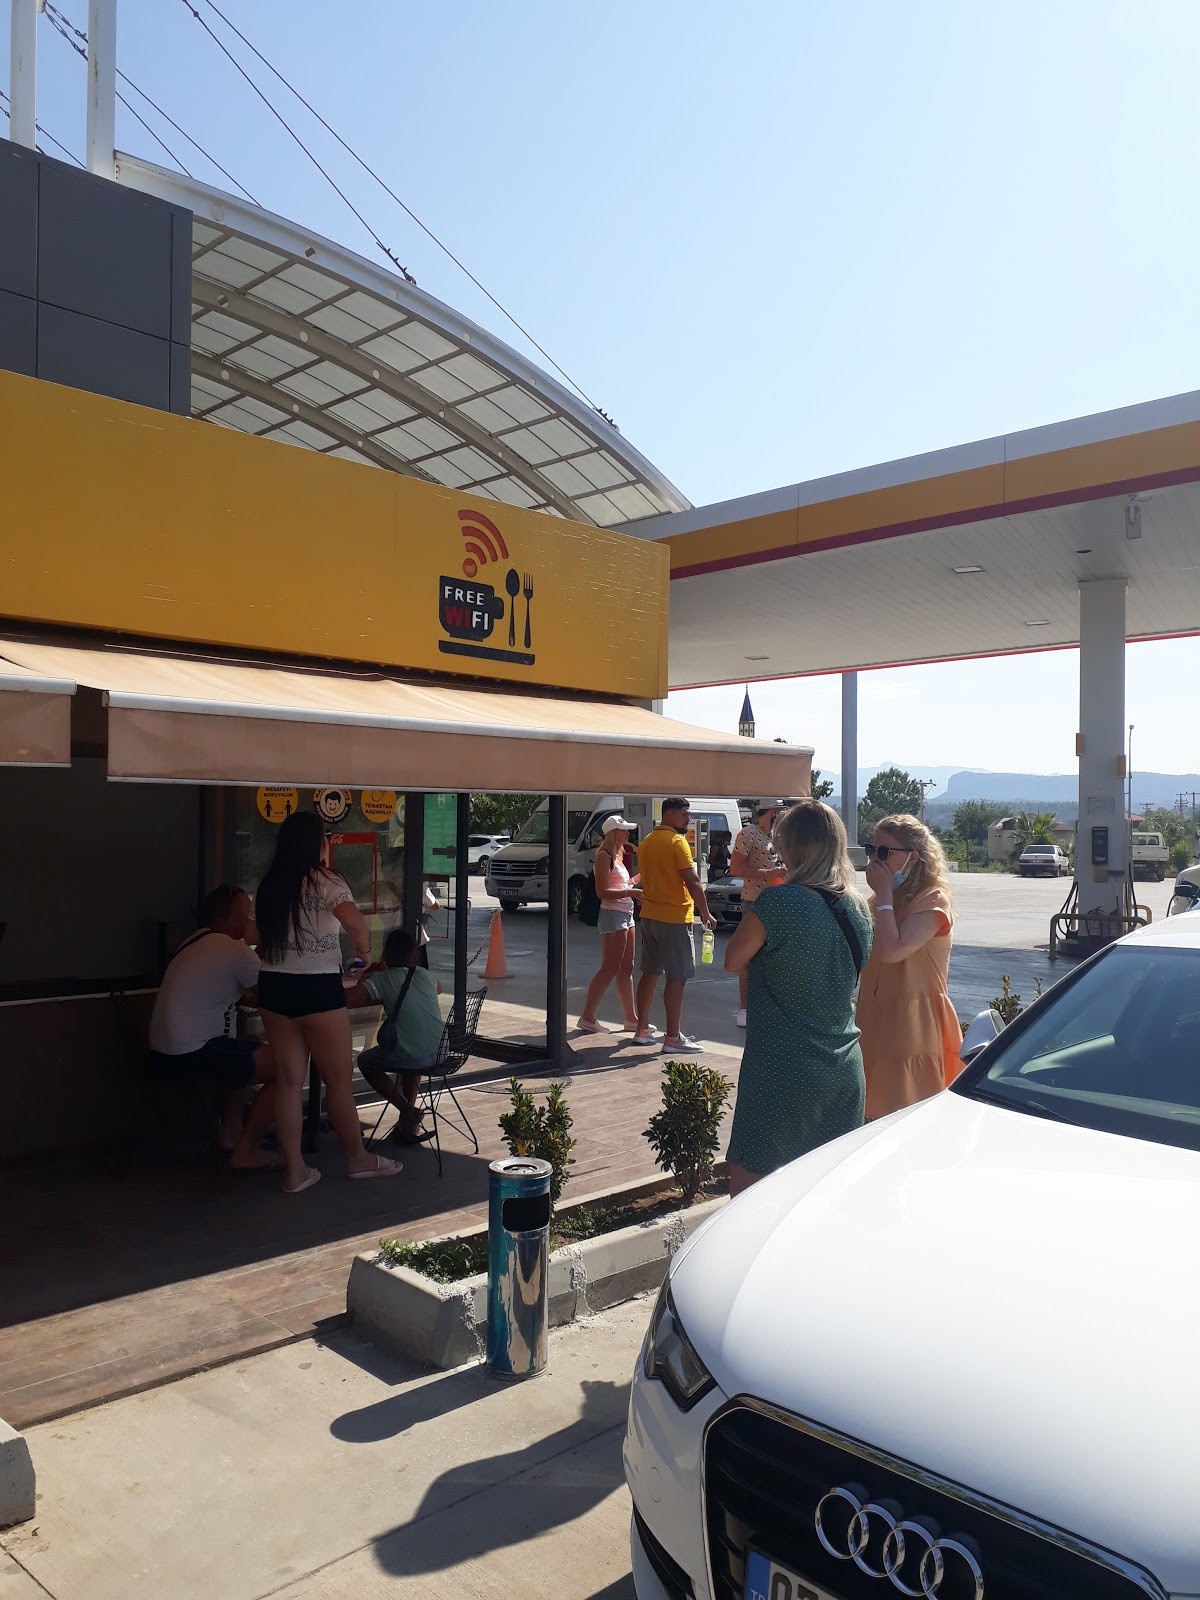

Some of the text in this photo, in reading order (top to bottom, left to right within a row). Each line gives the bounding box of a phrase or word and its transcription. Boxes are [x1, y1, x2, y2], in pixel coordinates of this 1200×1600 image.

[444, 585, 485, 605] FREE
[443, 605, 489, 631] WIFI
[771, 1572, 819, 1600] 0
